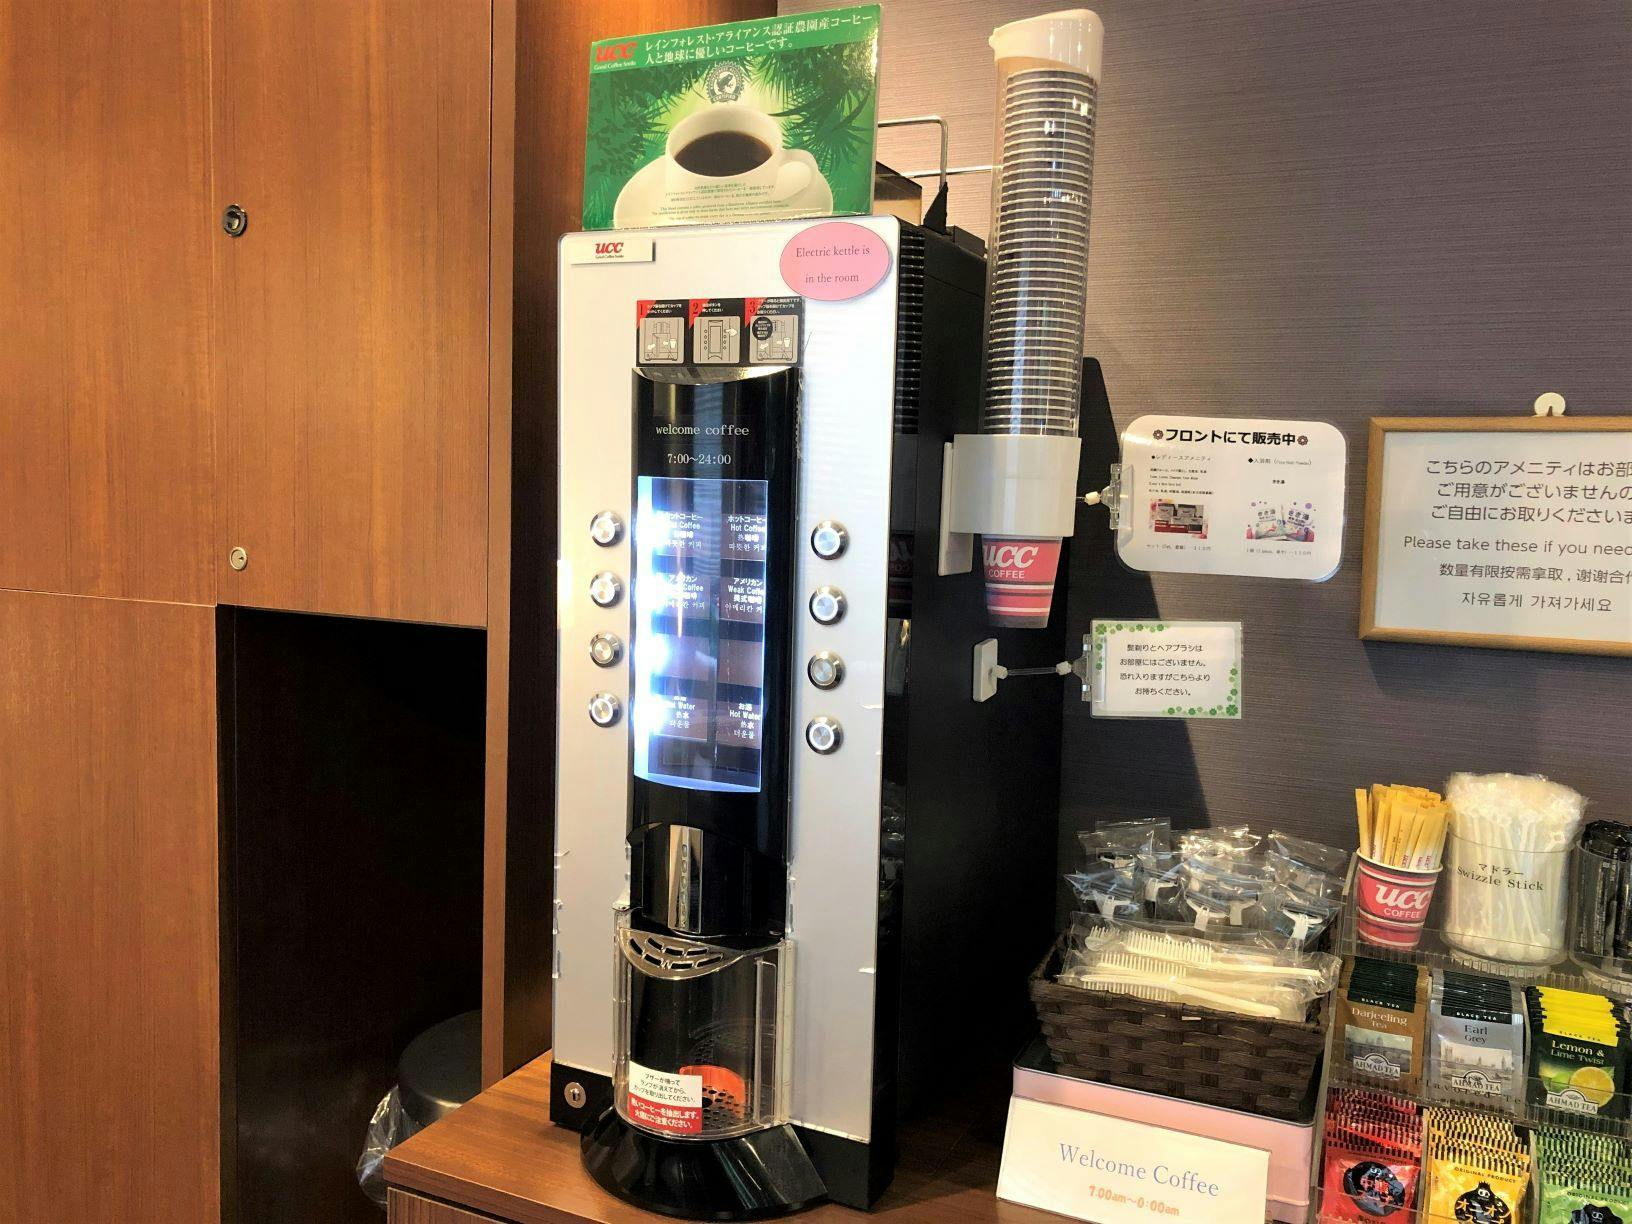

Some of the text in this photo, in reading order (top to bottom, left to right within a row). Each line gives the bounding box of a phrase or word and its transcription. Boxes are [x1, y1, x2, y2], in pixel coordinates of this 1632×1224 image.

[645, 36, 794, 66] 人と地球に優しいコーヒーです。
[796, 244, 870, 258] Electric kettle is
[805, 273, 859, 283] in the room
[656, 424, 750, 436] welcome coffee
[1165, 429, 1296, 446] フロントにて販売中
[730, 524, 742, 532] Hot
[1403, 536, 1452, 549] Please
[1456, 537, 1490, 551] take
[1495, 538, 1538, 553] these
[1543, 540, 1554, 553] if
[1557, 543, 1588, 557] you
[988, 568, 1025, 579] COFFEE
[733, 577, 763, 587] アメリカン
[1461, 592, 1613, 613] 자유롭게 가져가세요
[1126, 644, 1204, 652] 髭剃りとヘアブラシは
[1119, 658, 1206, 667] お部屋にはございません。
[1119, 673, 1211, 682] 恐れ入りますがこちらより
[1134, 688, 1191, 696] お持ちください。
[729, 709, 741, 718] Hot
[1478, 863, 1525, 876] マドラー
[1456, 865, 1544, 891] Swizzle Stick
[1361, 997, 1383, 1005] BLACK
[1351, 1007, 1408, 1026] Darjeeling
[1456, 1011, 1480, 1019] BLACK
[1372, 1020, 1387, 1029] Tea
[1464, 1024, 1488, 1035] Earl
[1464, 1034, 1488, 1044] Grey
[1552, 1040, 1605, 1057] Lemon &
[1551, 1048, 1605, 1065] Lime Twist
[1354, 1060, 1399, 1075] AHMAD TEA
[1453, 1079, 1500, 1092] AHMAD TEA
[1549, 1096, 1596, 1112] AHMAD TEA
[1059, 1142, 1220, 1197] Welcome Coffee
